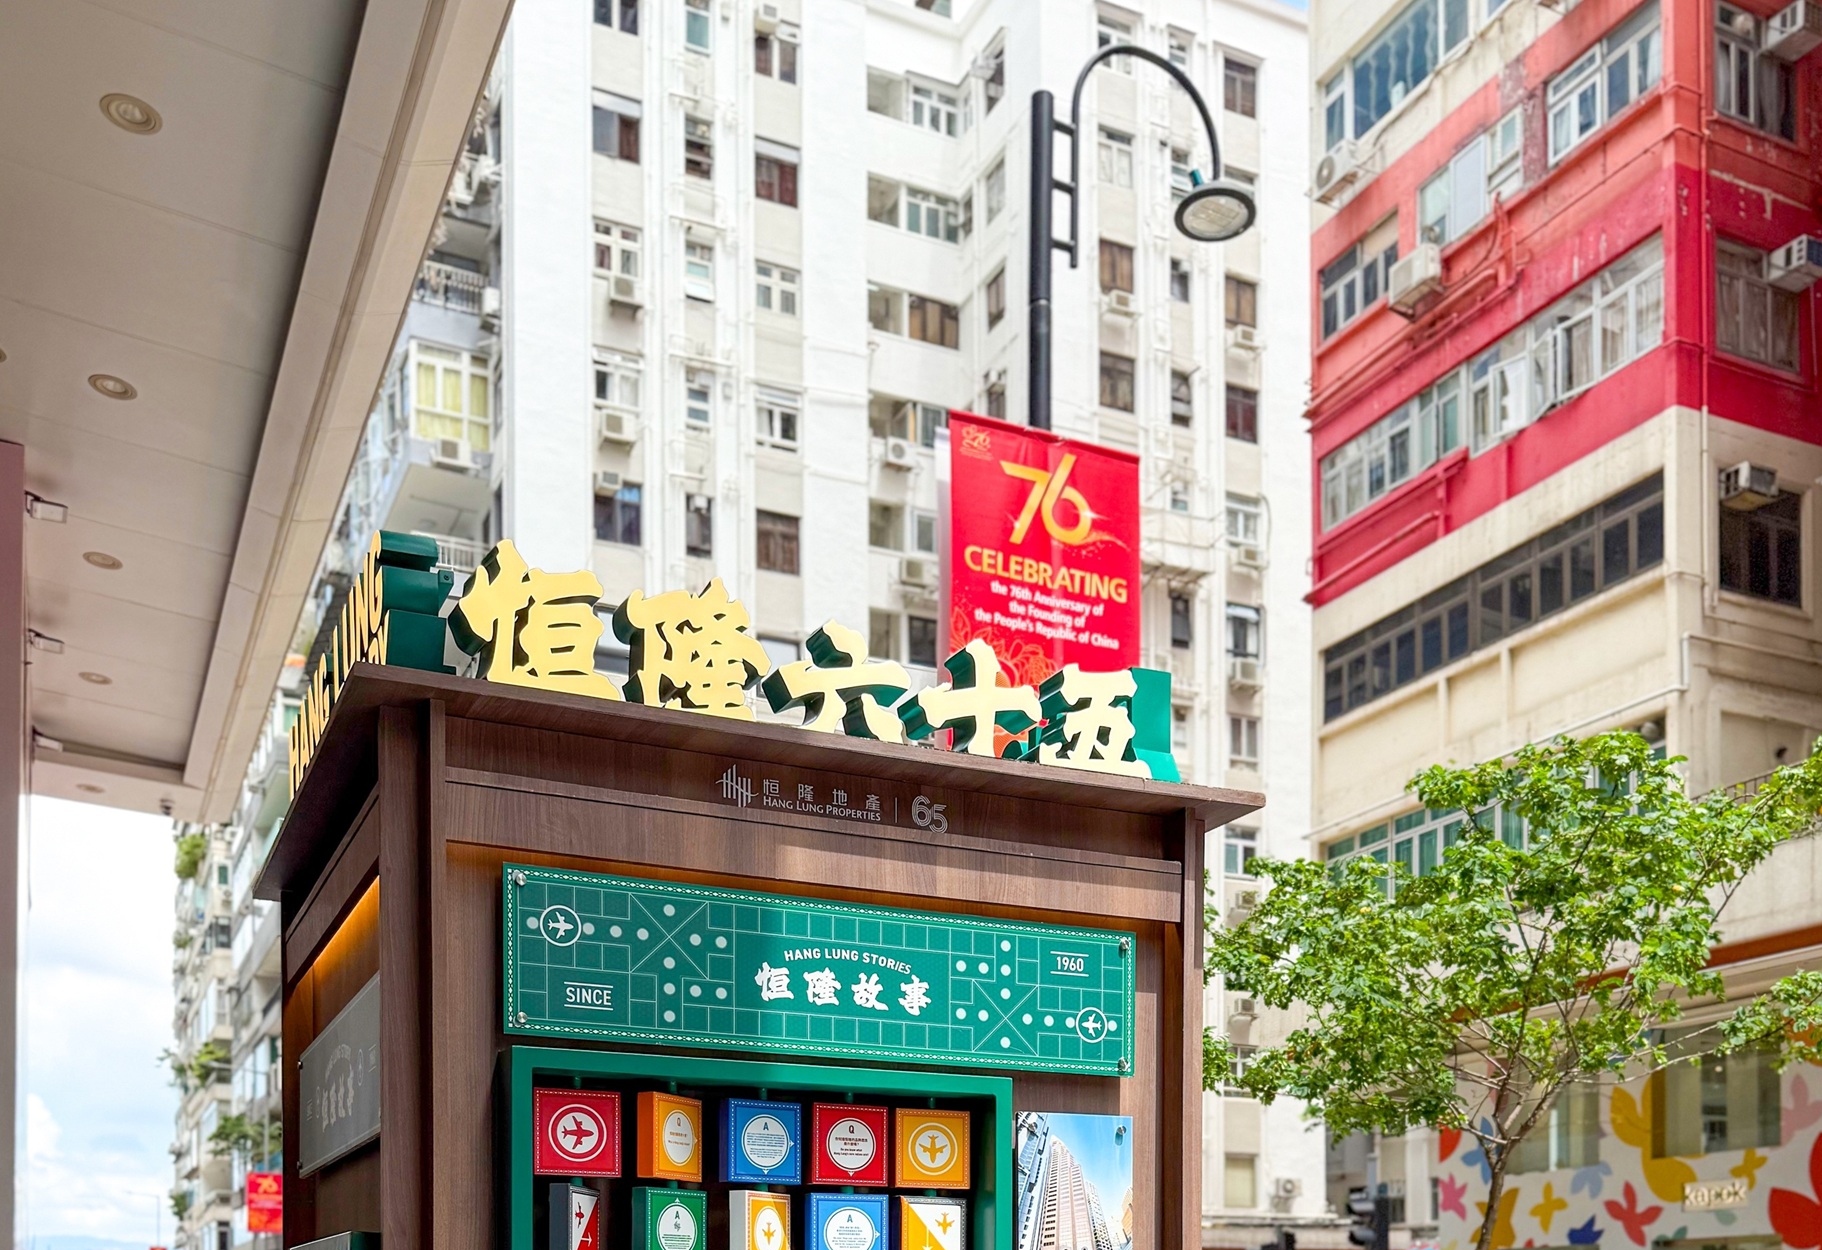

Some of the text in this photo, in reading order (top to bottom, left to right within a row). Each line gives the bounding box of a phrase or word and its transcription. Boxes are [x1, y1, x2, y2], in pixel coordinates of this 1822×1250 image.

[1000, 453, 1093, 546] 76
[964, 545, 1128, 603] CELEBRATING
[991, 580, 1104, 617] the 76th Anniversary of
[1009, 600, 1086, 628] the Founding of
[975, 608, 1119, 649] the People's Republic of China
[458, 539, 1150, 779] 恒隆六十五
[763, 779, 881, 811] 恒隆地產
[763, 796, 881, 822] HANG LUNG PROPERTIES
[911, 794, 948, 834] 65
[783, 947, 913, 976] HANG LUNG STORIES
[1056, 954, 1085, 974] 1960
[565, 986, 612, 1008] SINCE
[755, 961, 932, 1017] 恒隆故事
